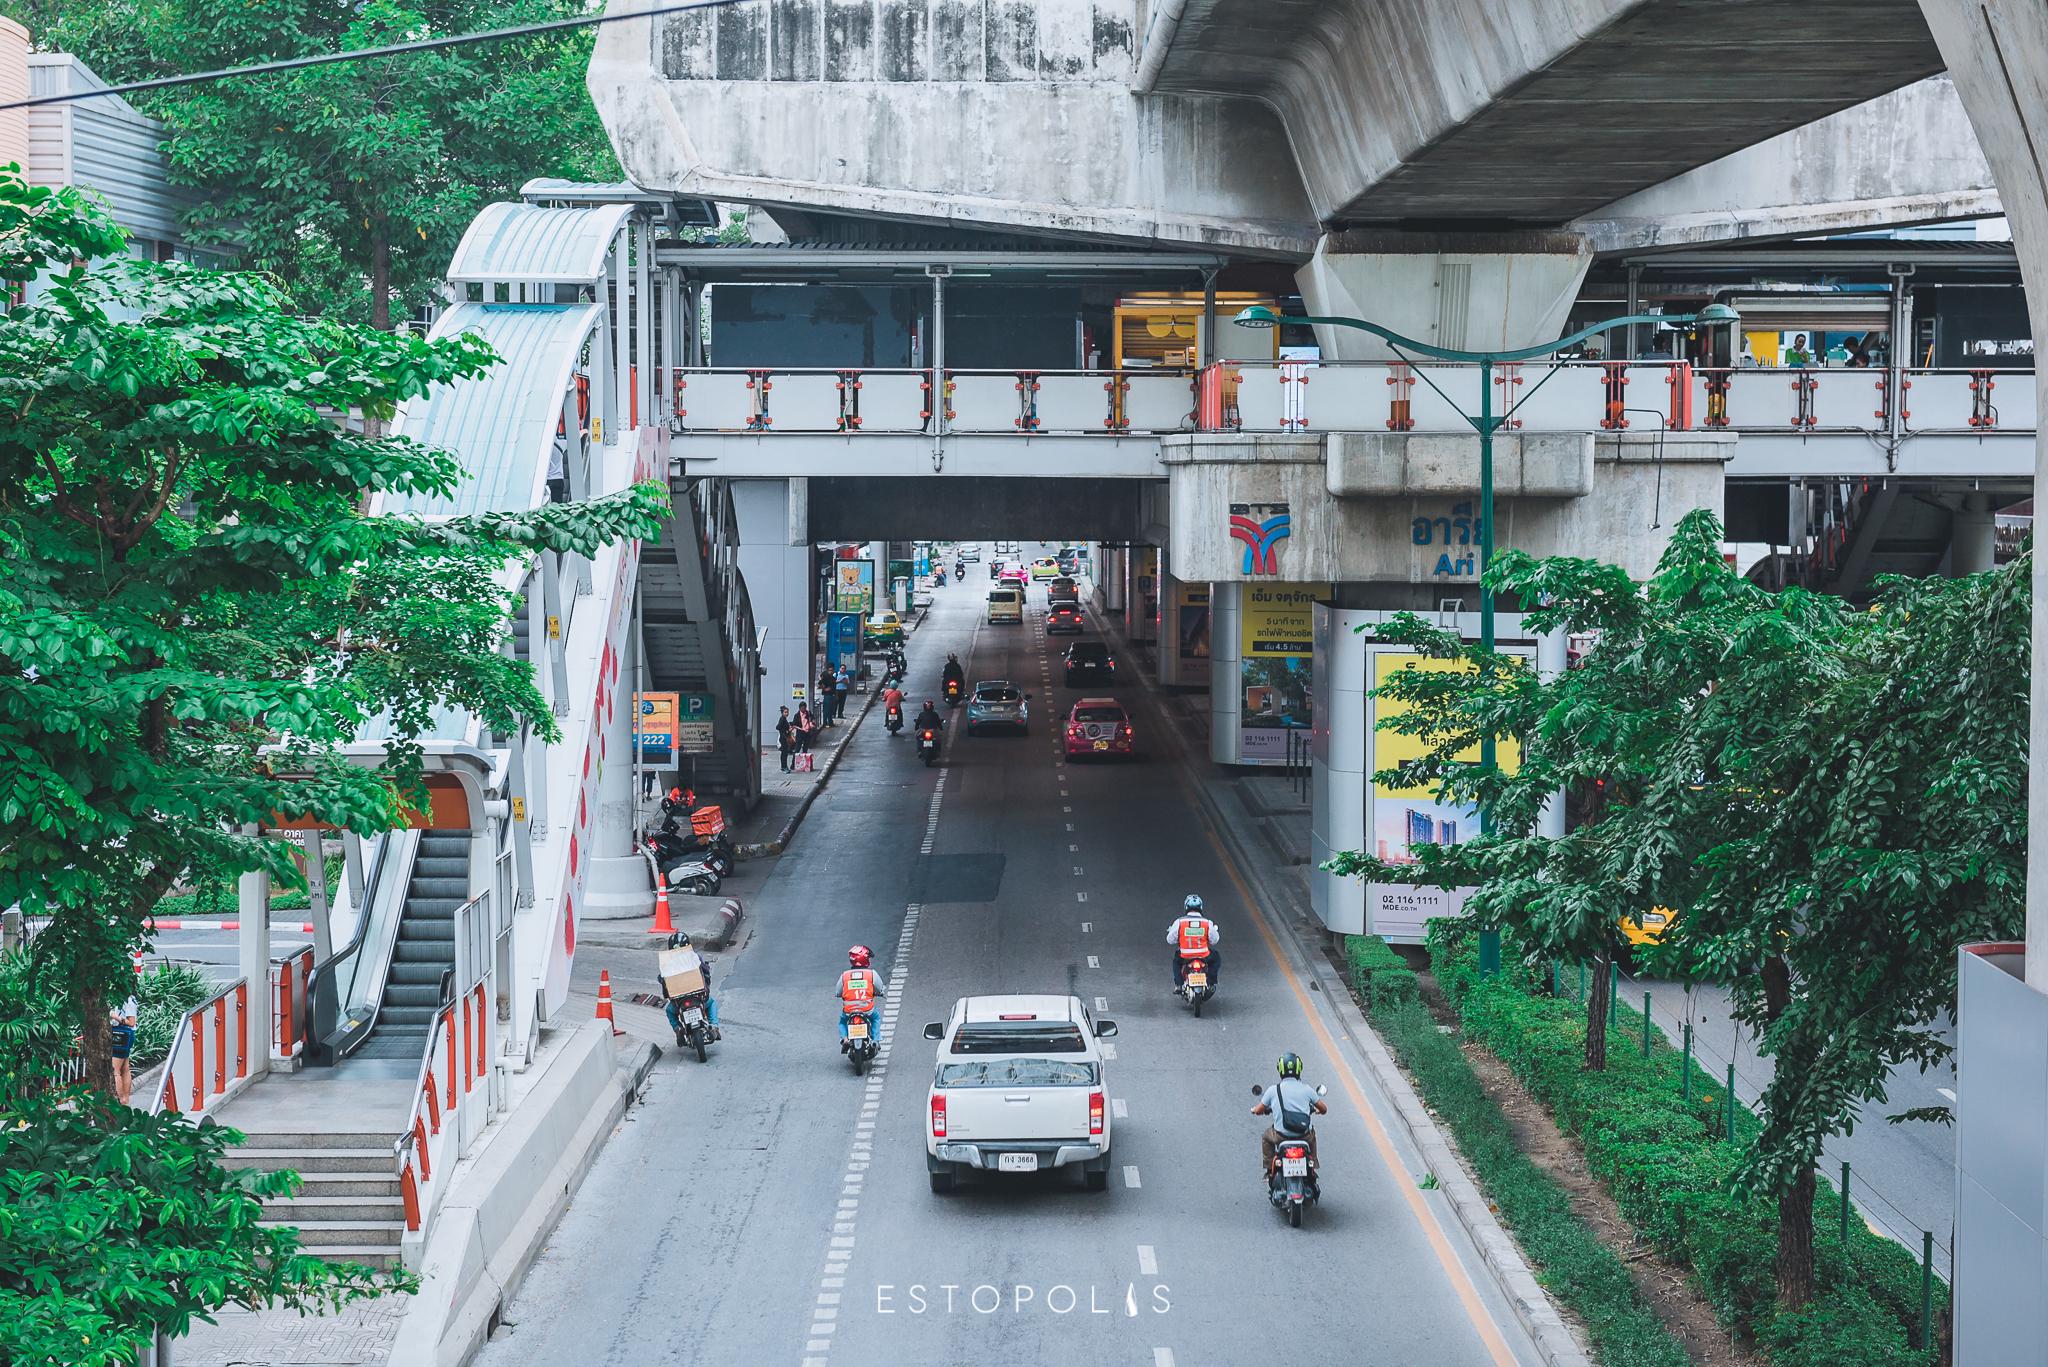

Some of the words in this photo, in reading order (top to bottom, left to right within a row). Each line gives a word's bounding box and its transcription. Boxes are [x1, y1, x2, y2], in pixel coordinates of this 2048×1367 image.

[1433, 552, 1474, 576] Ari
[689, 698, 702, 713] P
[643, 735, 665, 745] 222
[284, 829, 304, 838] อาคา
[1382, 895, 1394, 904] 02
[1397, 896, 1414, 904] 116
[1416, 896, 1438, 905] 1111
[854, 989, 867, 1000] 12
